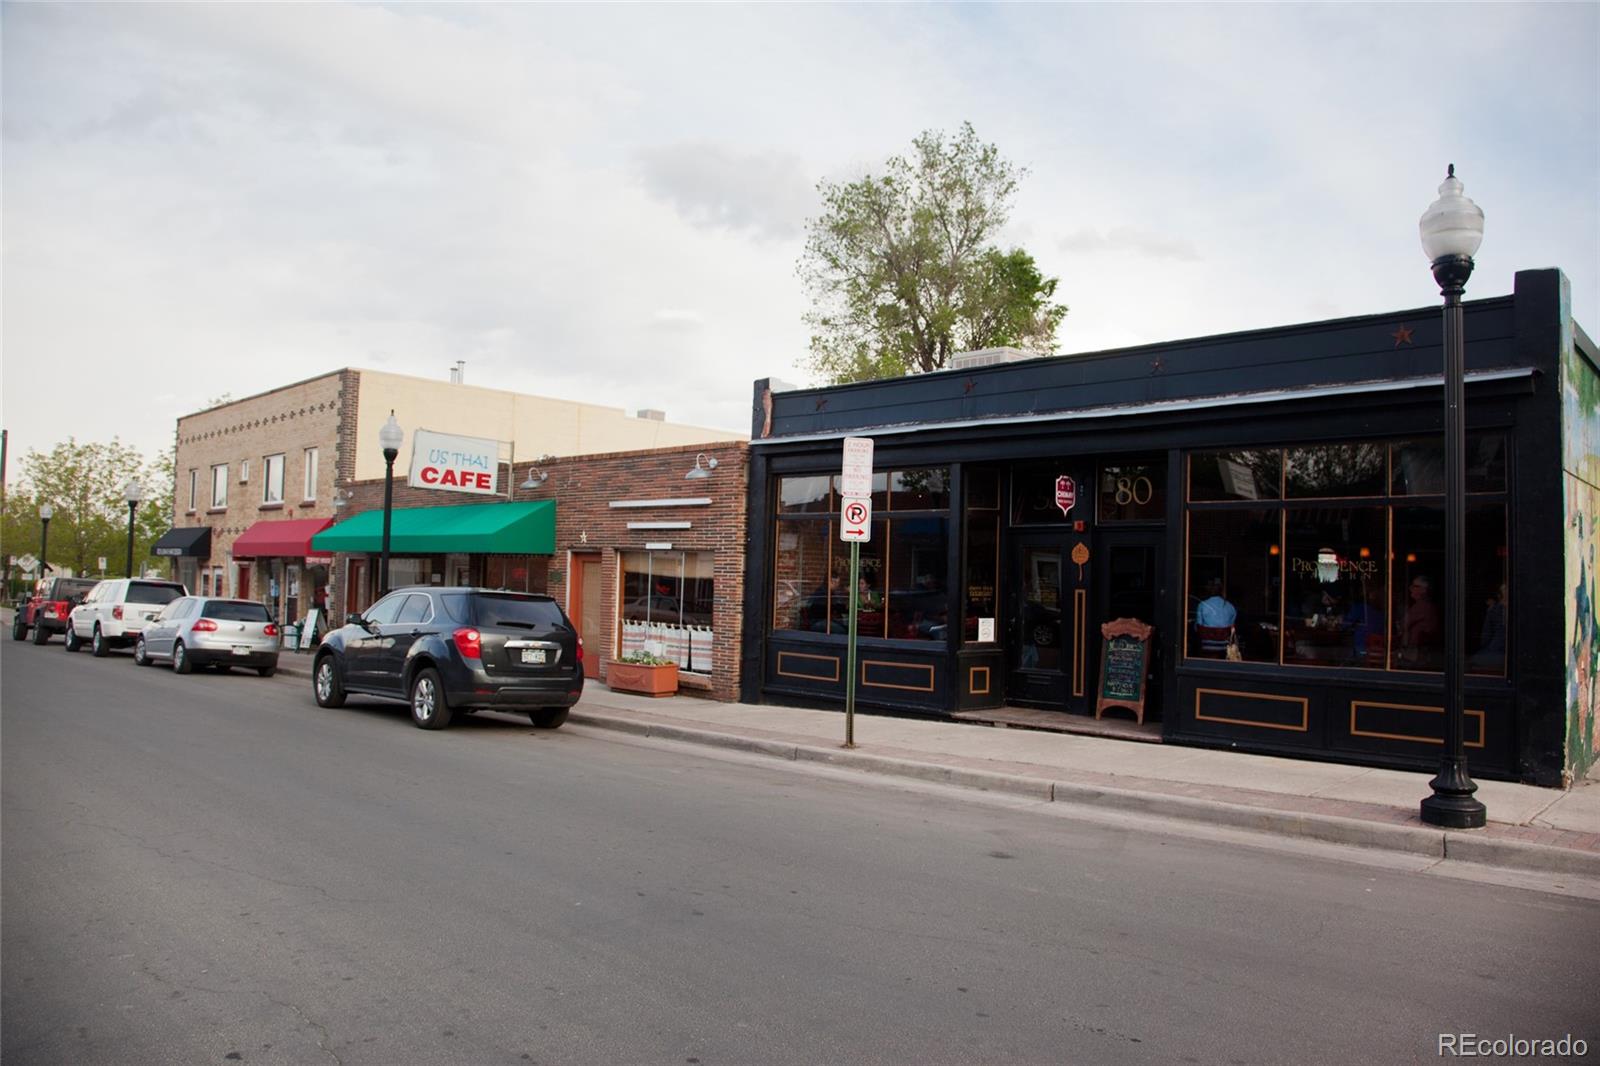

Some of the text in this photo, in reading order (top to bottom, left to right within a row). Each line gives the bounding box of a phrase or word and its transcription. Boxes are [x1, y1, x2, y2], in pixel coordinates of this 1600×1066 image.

[429, 449, 488, 469] US THAI
[421, 466, 491, 489] CAFE
